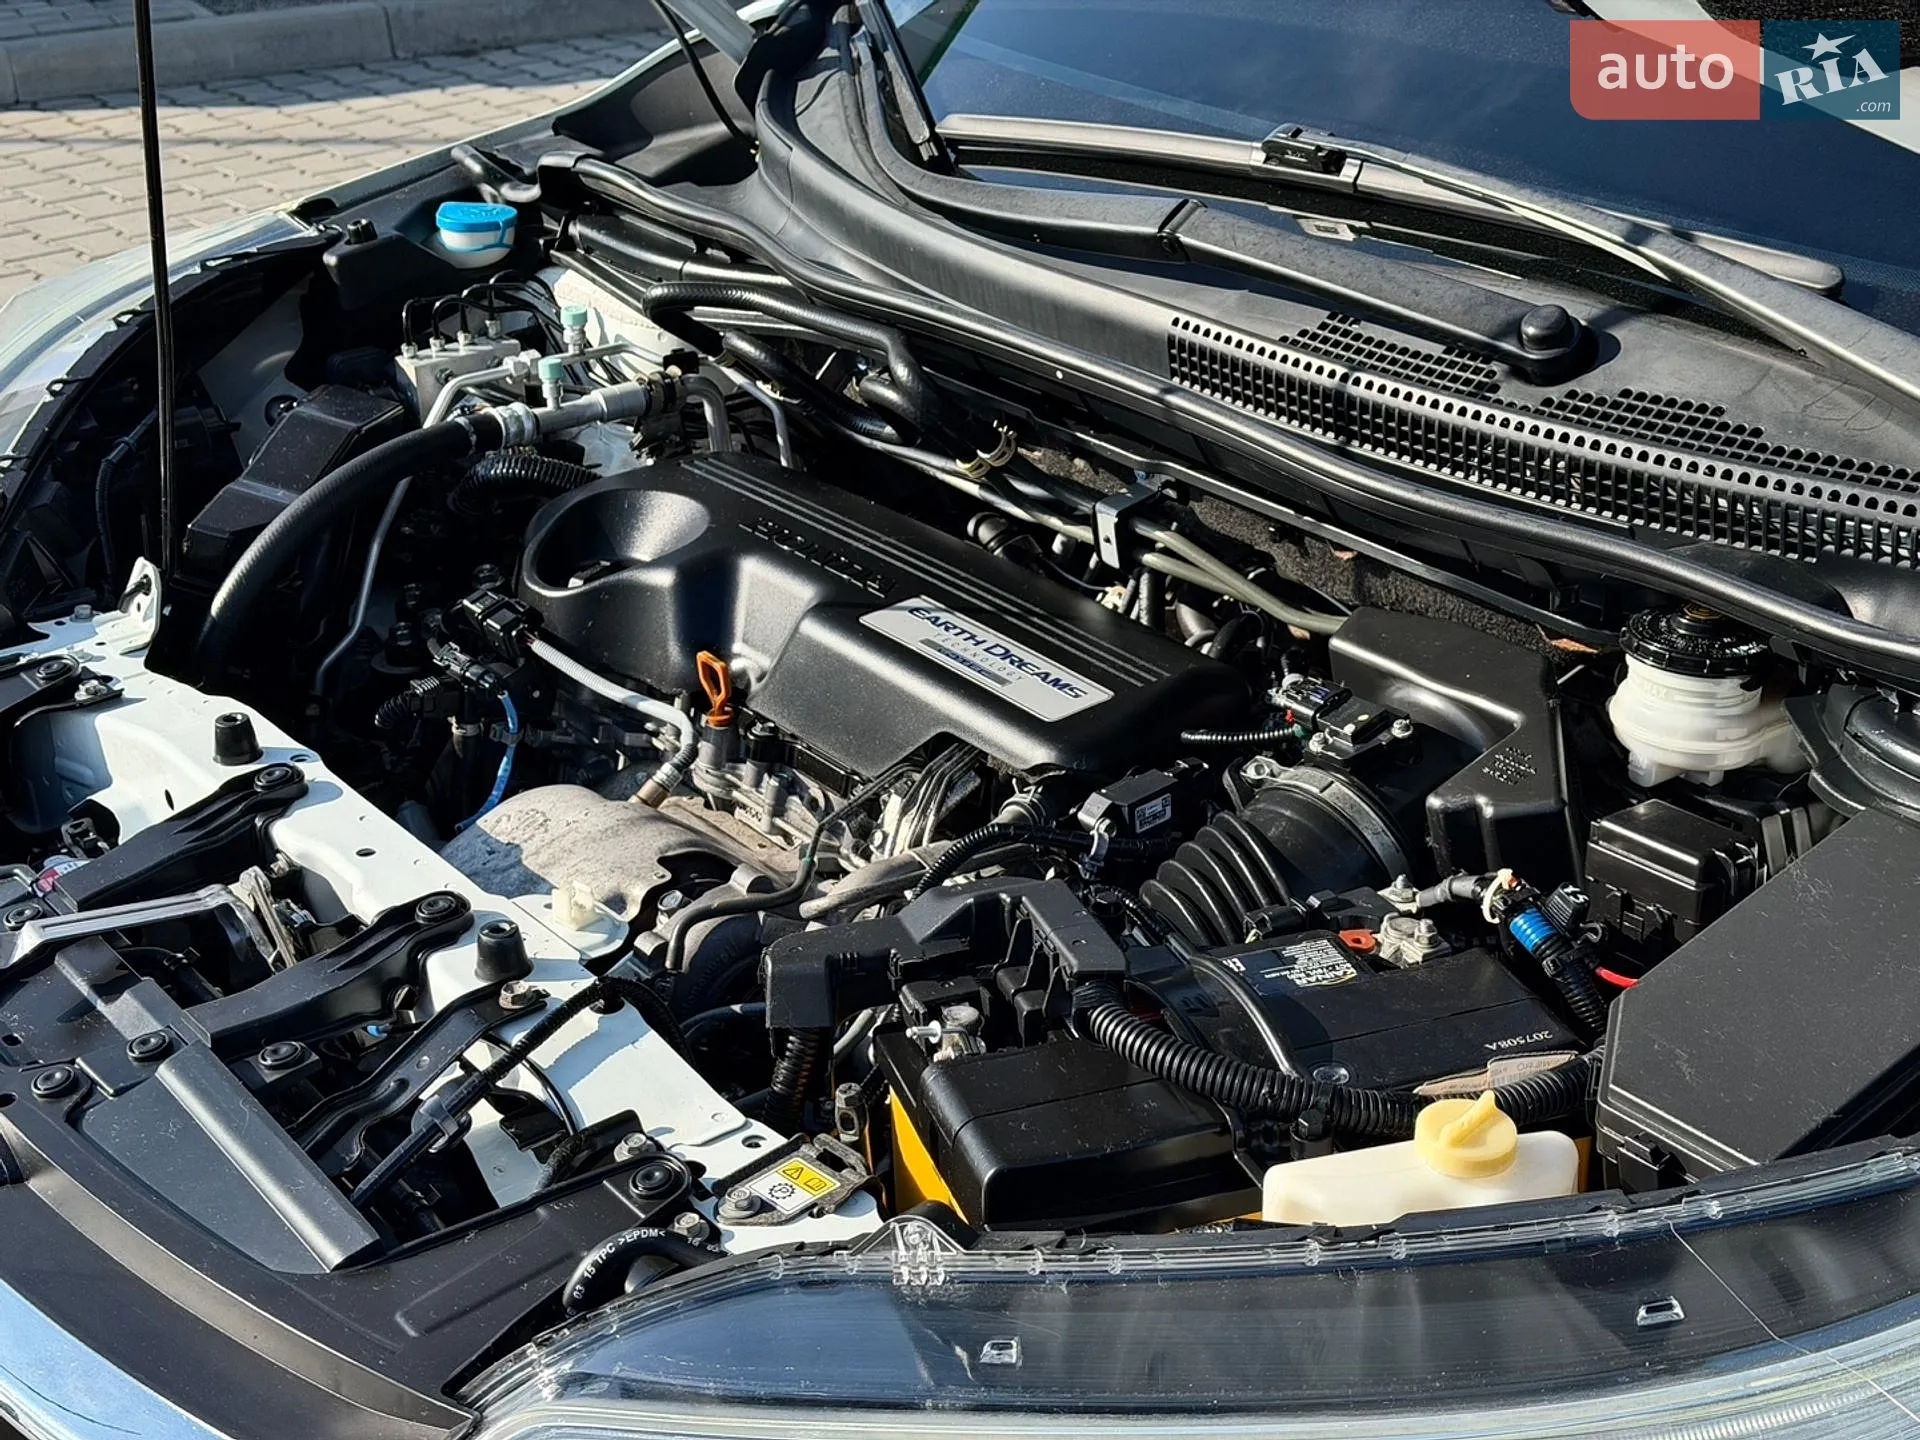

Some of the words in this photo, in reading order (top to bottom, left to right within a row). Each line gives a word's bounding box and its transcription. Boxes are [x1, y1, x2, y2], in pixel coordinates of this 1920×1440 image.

[907, 607, 986, 647] EARTH
[983, 643, 1089, 700] DREAMS
[583, 1266, 597, 1280] 15
[594, 1242, 617, 1265] TPC
